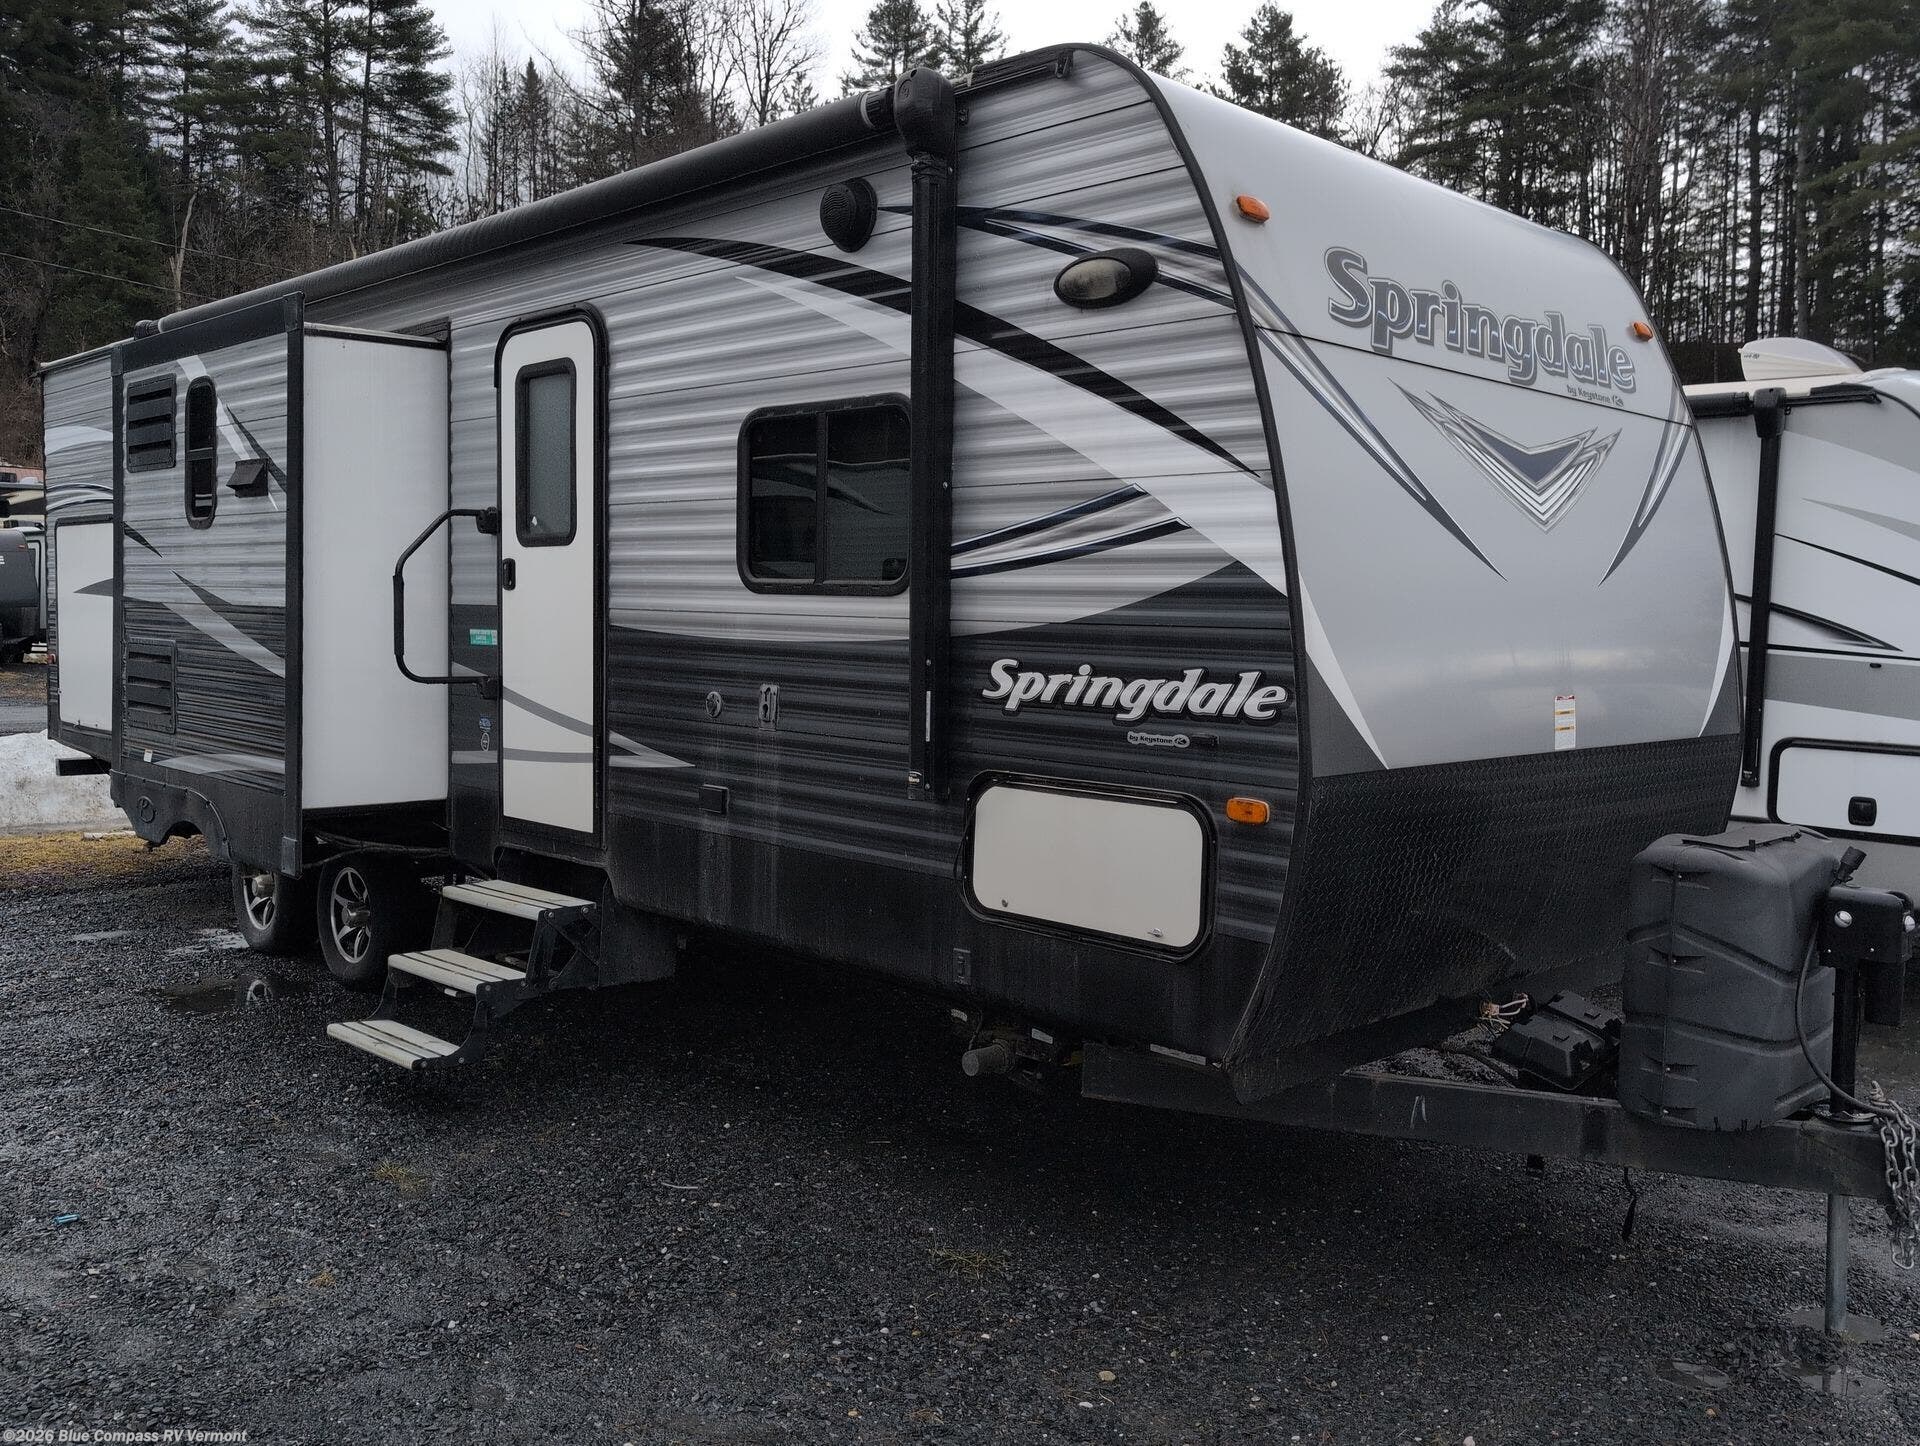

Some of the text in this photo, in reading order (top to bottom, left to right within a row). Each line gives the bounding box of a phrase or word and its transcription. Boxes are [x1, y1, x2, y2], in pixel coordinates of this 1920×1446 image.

[1323, 246, 1636, 393] Springdale
[1566, 384, 1611, 403] by Keystone
[981, 658, 1288, 723] Springdale
[1129, 734, 1174, 745] by Keystone
